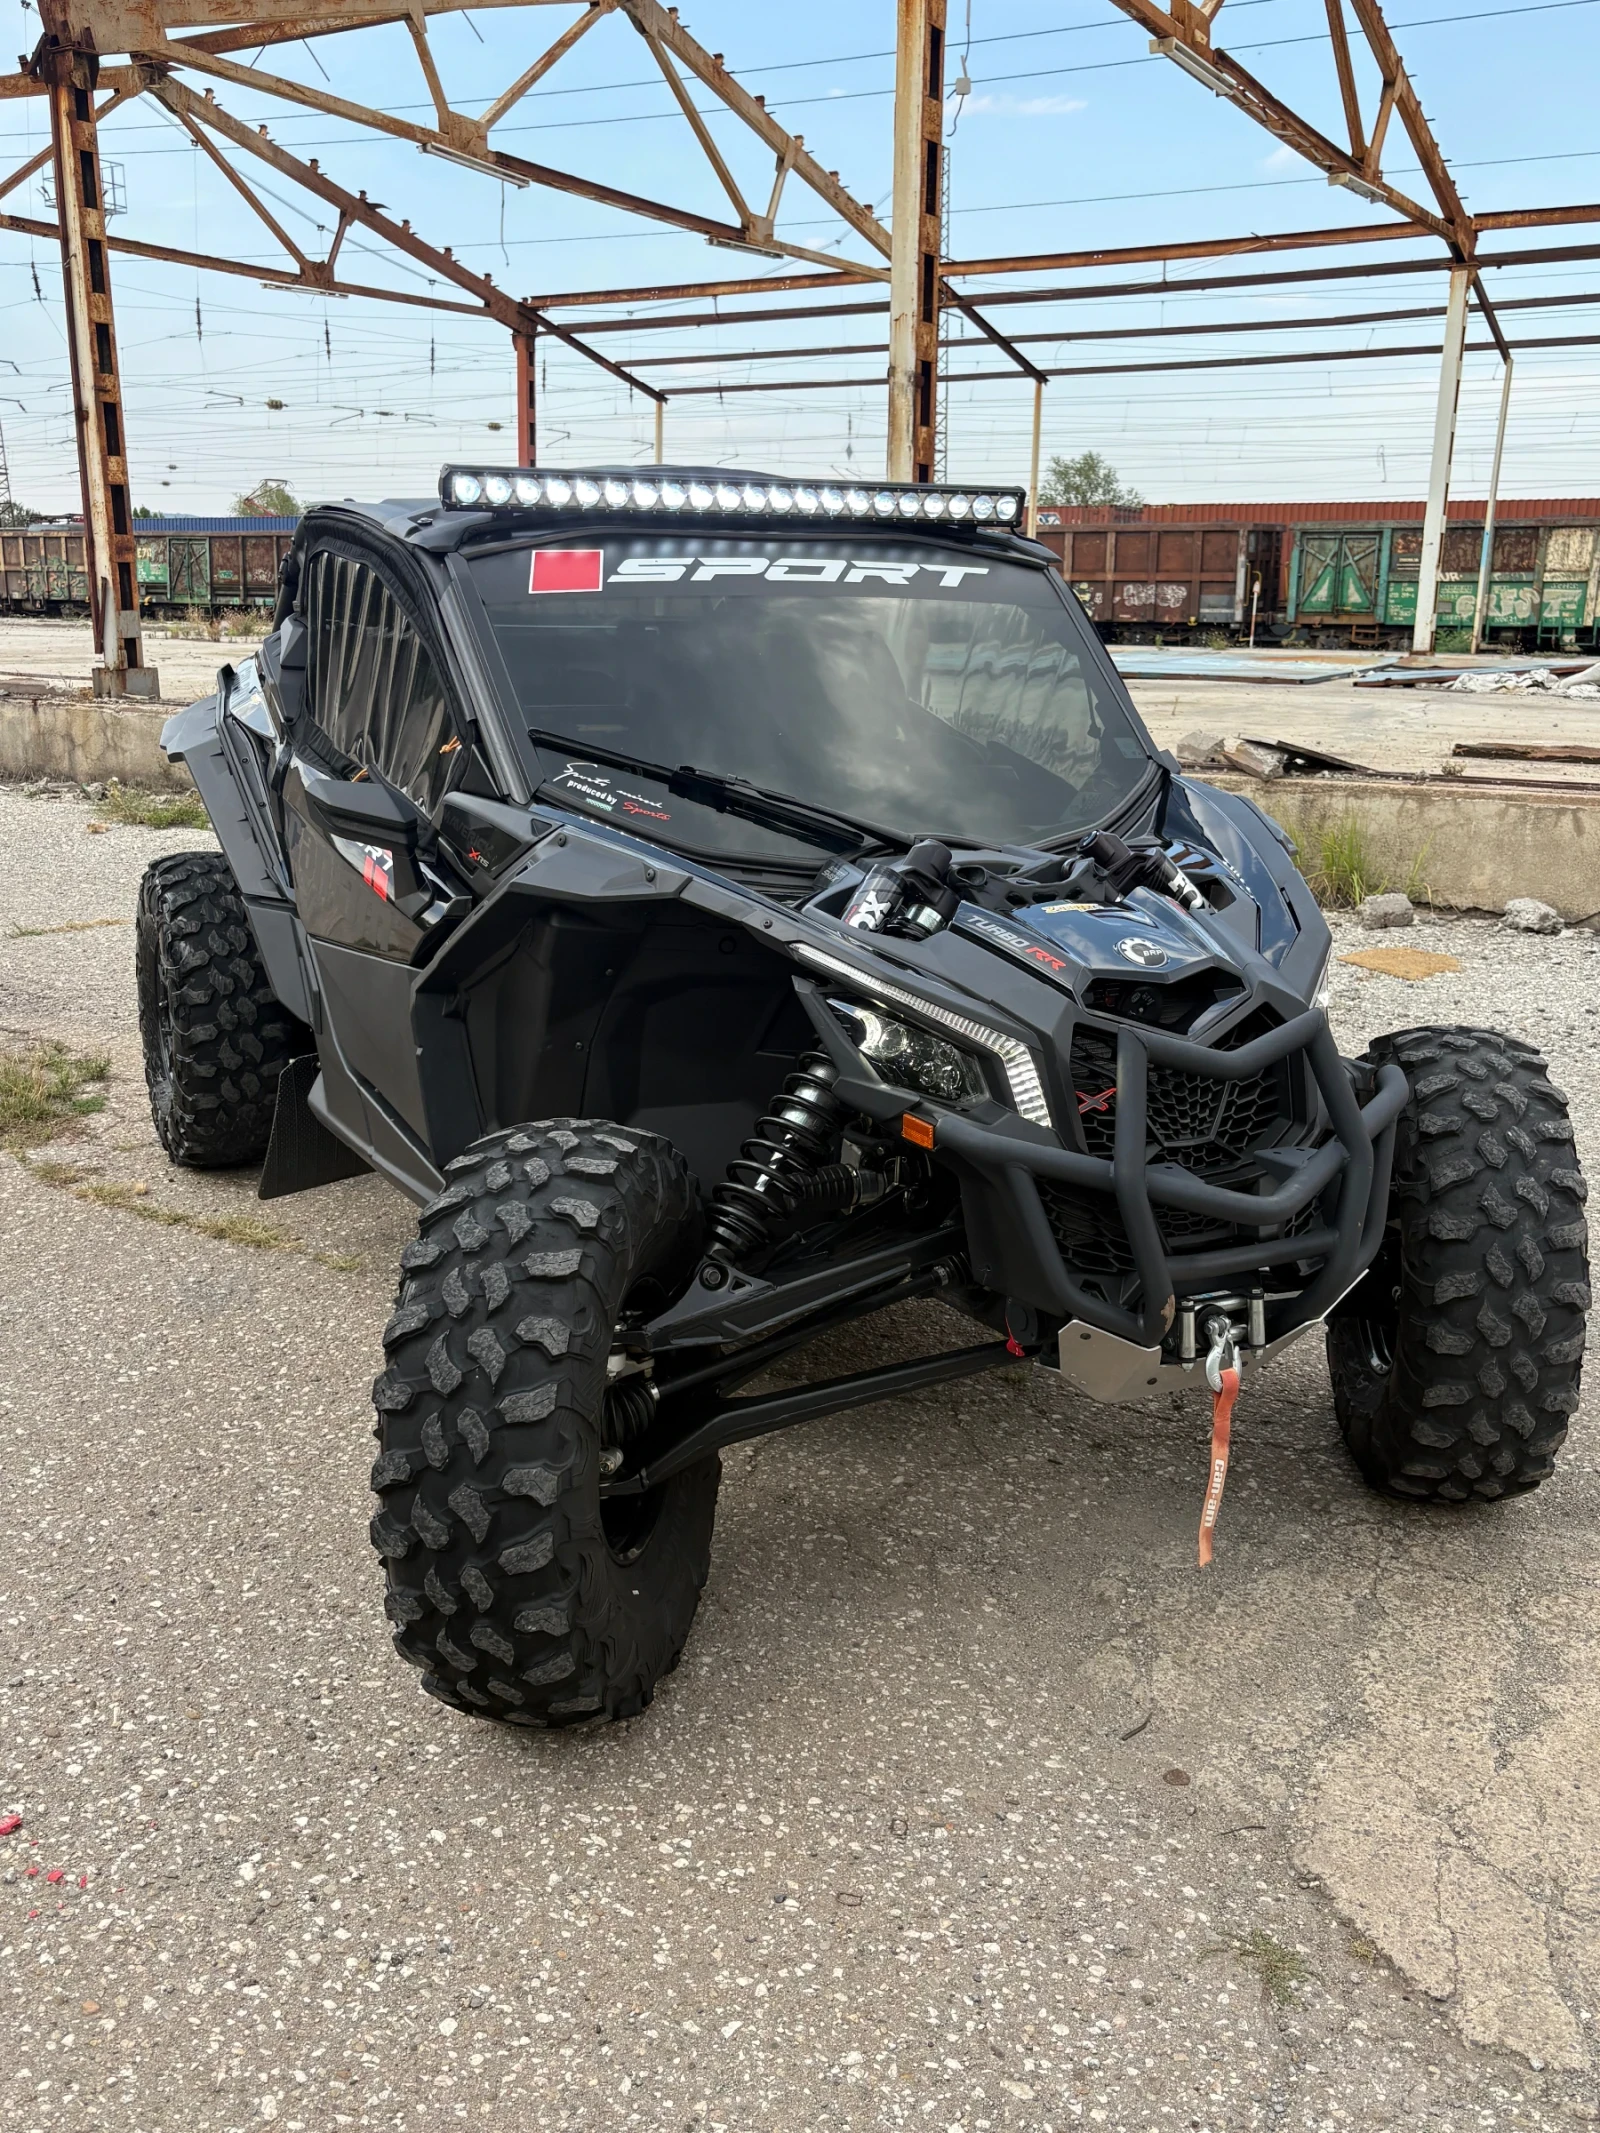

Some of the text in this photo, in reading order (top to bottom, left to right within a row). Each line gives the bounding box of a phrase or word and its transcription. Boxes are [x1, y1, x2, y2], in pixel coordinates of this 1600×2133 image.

[607, 557, 989, 587] SPORT
[967, 915, 1066, 971] TURBO RR
[1142, 949, 1163, 957] BRP
